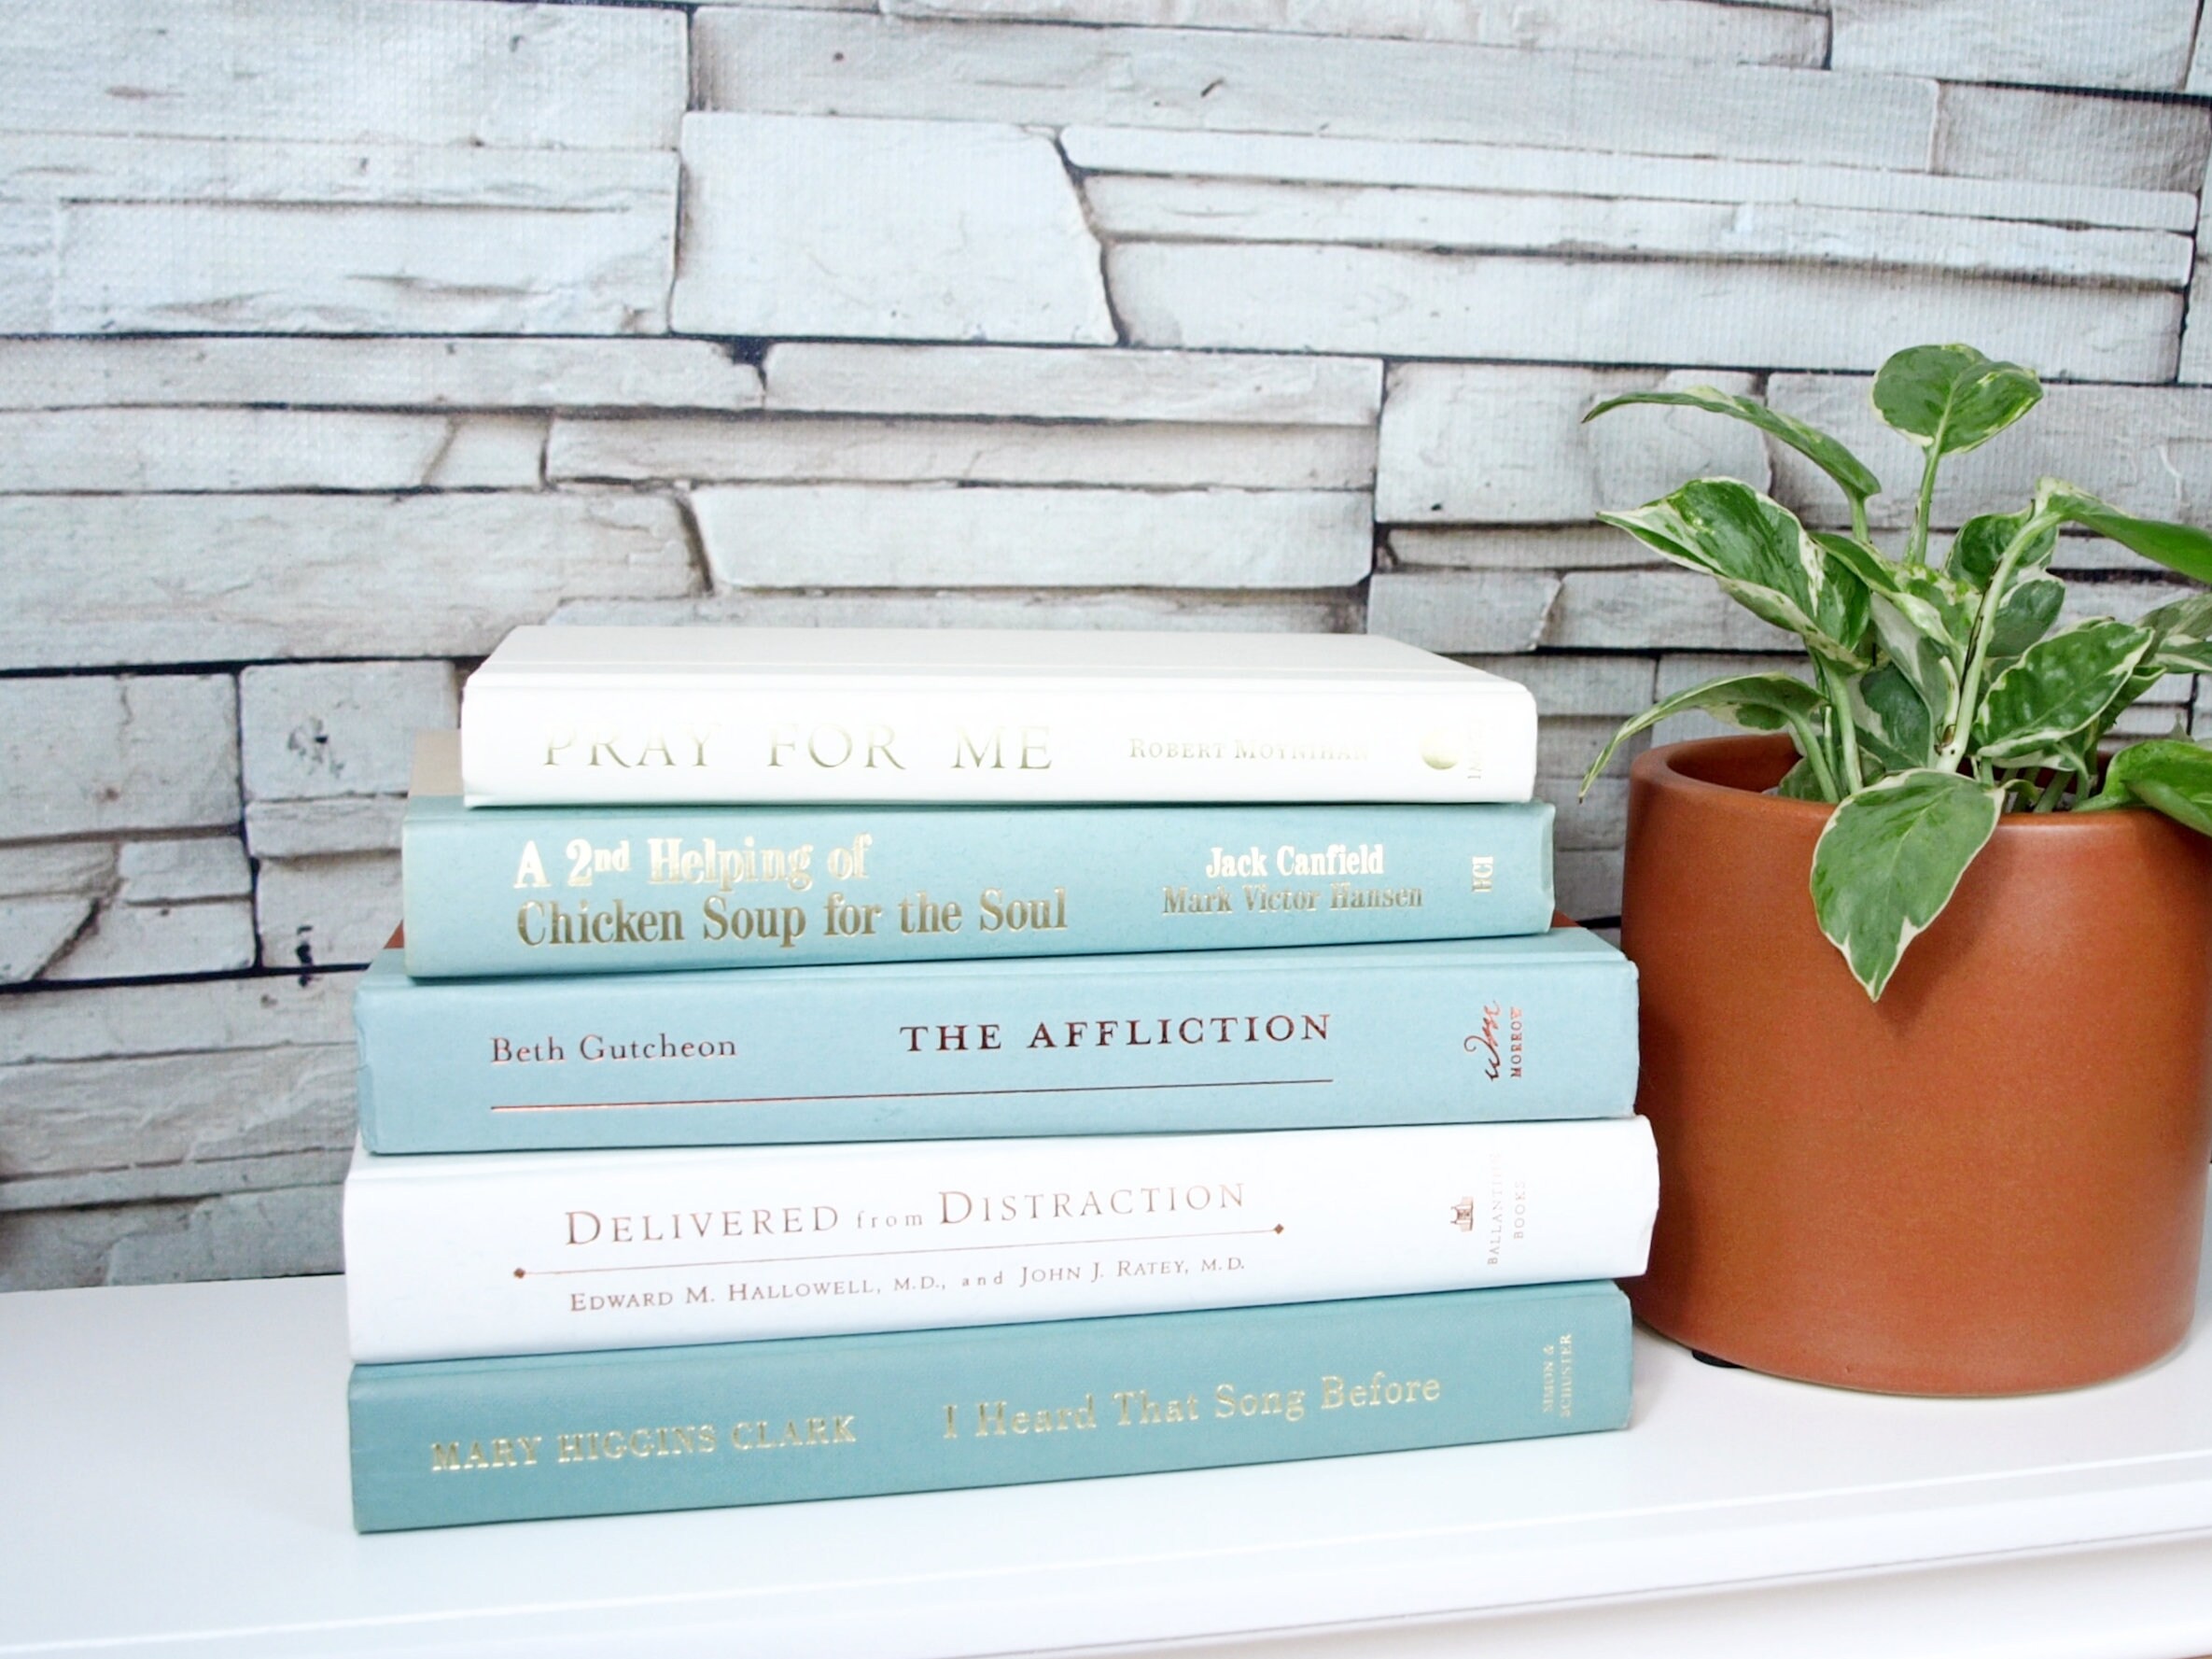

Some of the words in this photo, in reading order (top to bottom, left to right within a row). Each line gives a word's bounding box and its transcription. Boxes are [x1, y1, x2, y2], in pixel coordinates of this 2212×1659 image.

[542, 722, 722, 768] PRAY
[767, 722, 907, 770] FOR
[950, 724, 1053, 770] ME
[1128, 738, 1225, 759] ROBERT
[514, 839, 550, 888] A
[566, 837, 630, 886] 2nd
[647, 836, 814, 891] Helping
[827, 833, 873, 879] of
[1206, 846, 1268, 879] Jack
[1277, 844, 1384, 877] Canfield
[517, 898, 685, 947] Chicken
[702, 895, 806, 948] Soup
[824, 893, 882, 936] for
[899, 891, 962, 934] the
[980, 888, 1068, 933] Soul
[1161, 884, 1233, 916] Mark
[1242, 881, 1318, 913] Victor
[1330, 881, 1423, 909] Hansen
[490, 1036, 566, 1062] Beth
[580, 1033, 737, 1061] Gutcheon
[900, 1023, 1002, 1052] THE
[1026, 1013, 1331, 1049] AFFLICTION
[1510, 1006, 1523, 1078] MORROW
[565, 1205, 839, 1246] DELIVERED
[856, 1209, 923, 1230] from
[938, 1182, 1245, 1225] DISTRACTION
[1513, 1181, 1525, 1239] BOOKS
[570, 1290, 674, 1312] EDWARD
[686, 1285, 715, 1304] M.
[728, 1279, 882, 1302] HALLOWELL,
[960, 1271, 1005, 1287] and
[1018, 1266, 1081, 1288] JOHN
[1091, 1261, 1105, 1283] J.
[1117, 1259, 1189, 1278] RATEY,
[943, 1404, 959, 1440] I
[974, 1393, 1097, 1438] Heard
[1113, 1389, 1200, 1427] That
[1214, 1383, 1306, 1423] Song
[1321, 1371, 1442, 1410] Before
[1543, 1360, 1554, 1413] SIMON
[430, 1435, 542, 1471] MARY
[557, 1424, 718, 1463] HIGGINS
[732, 1415, 857, 1451] CLARK
